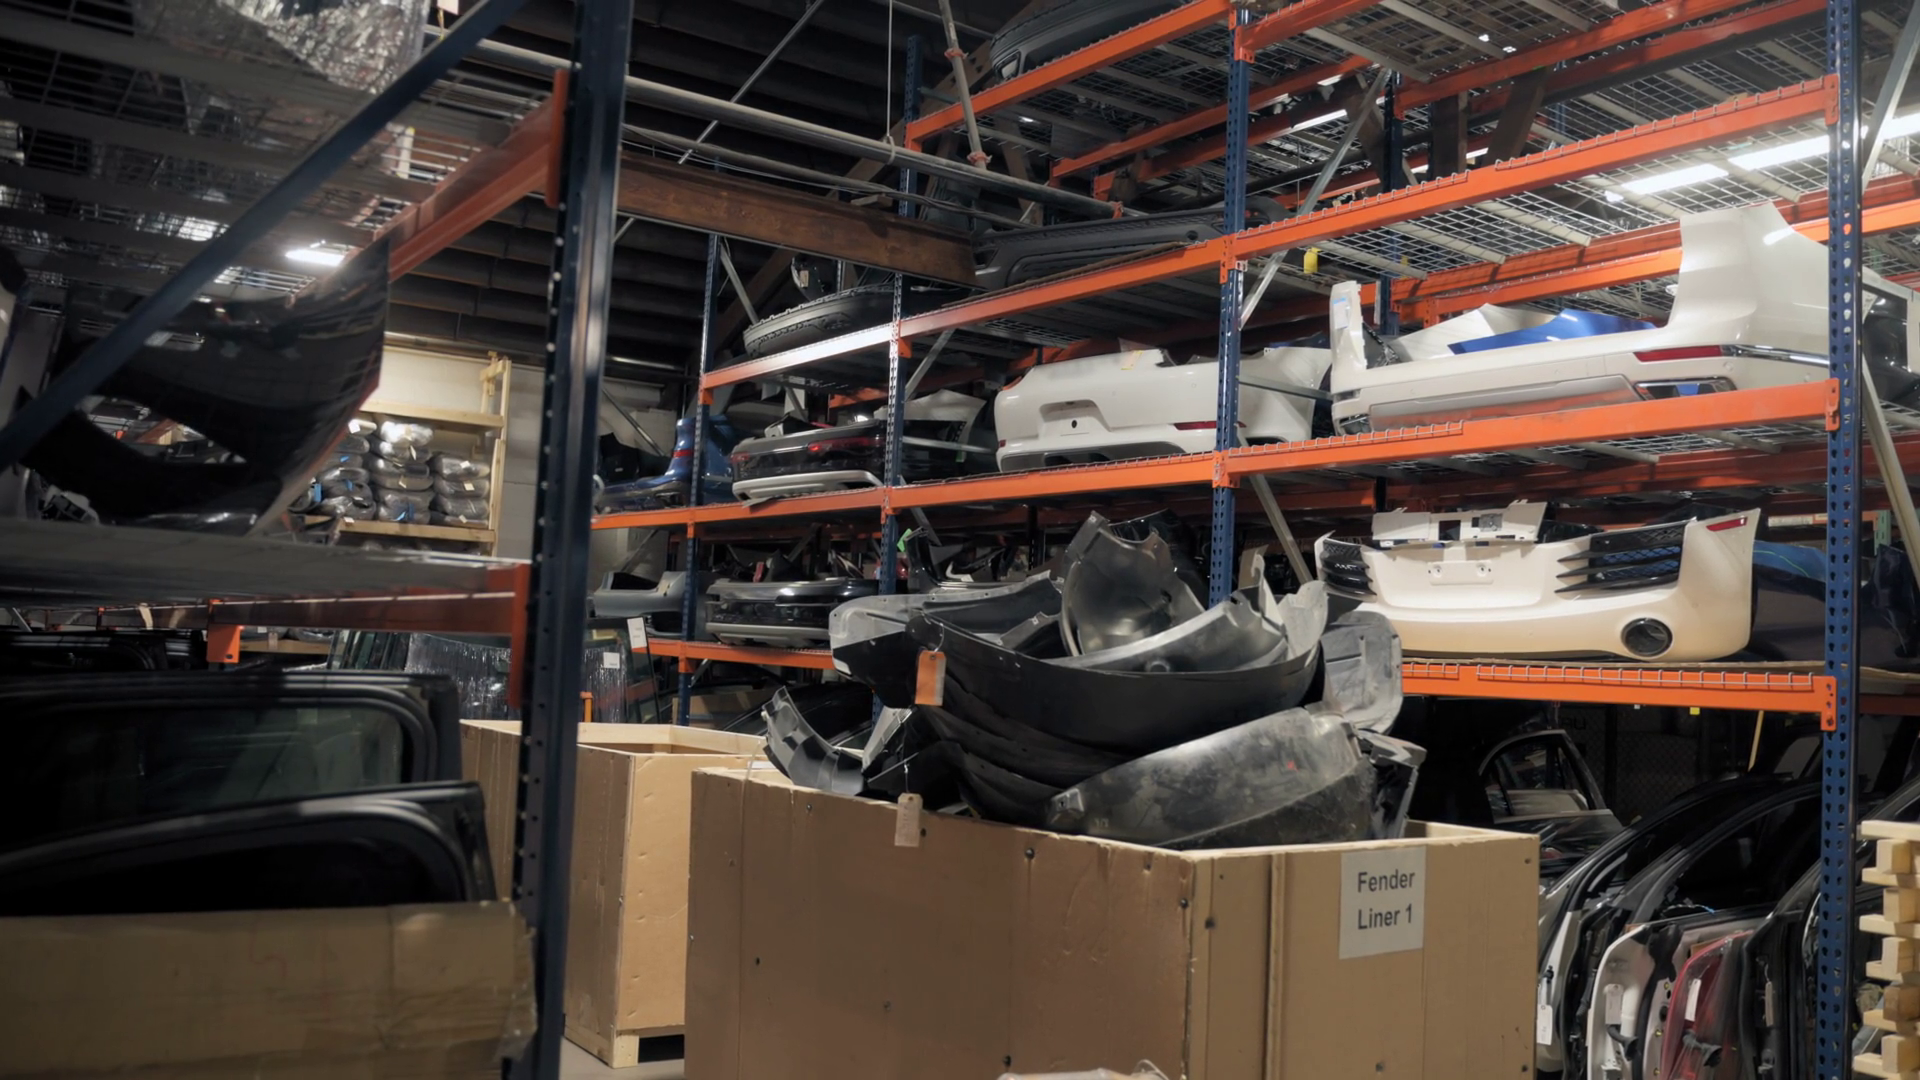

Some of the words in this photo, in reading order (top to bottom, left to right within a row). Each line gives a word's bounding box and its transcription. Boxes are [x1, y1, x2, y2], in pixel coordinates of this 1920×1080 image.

[1357, 869, 1416, 893] Fender
[1357, 907, 1401, 930] Liner
[1405, 903, 1413, 924] 1
